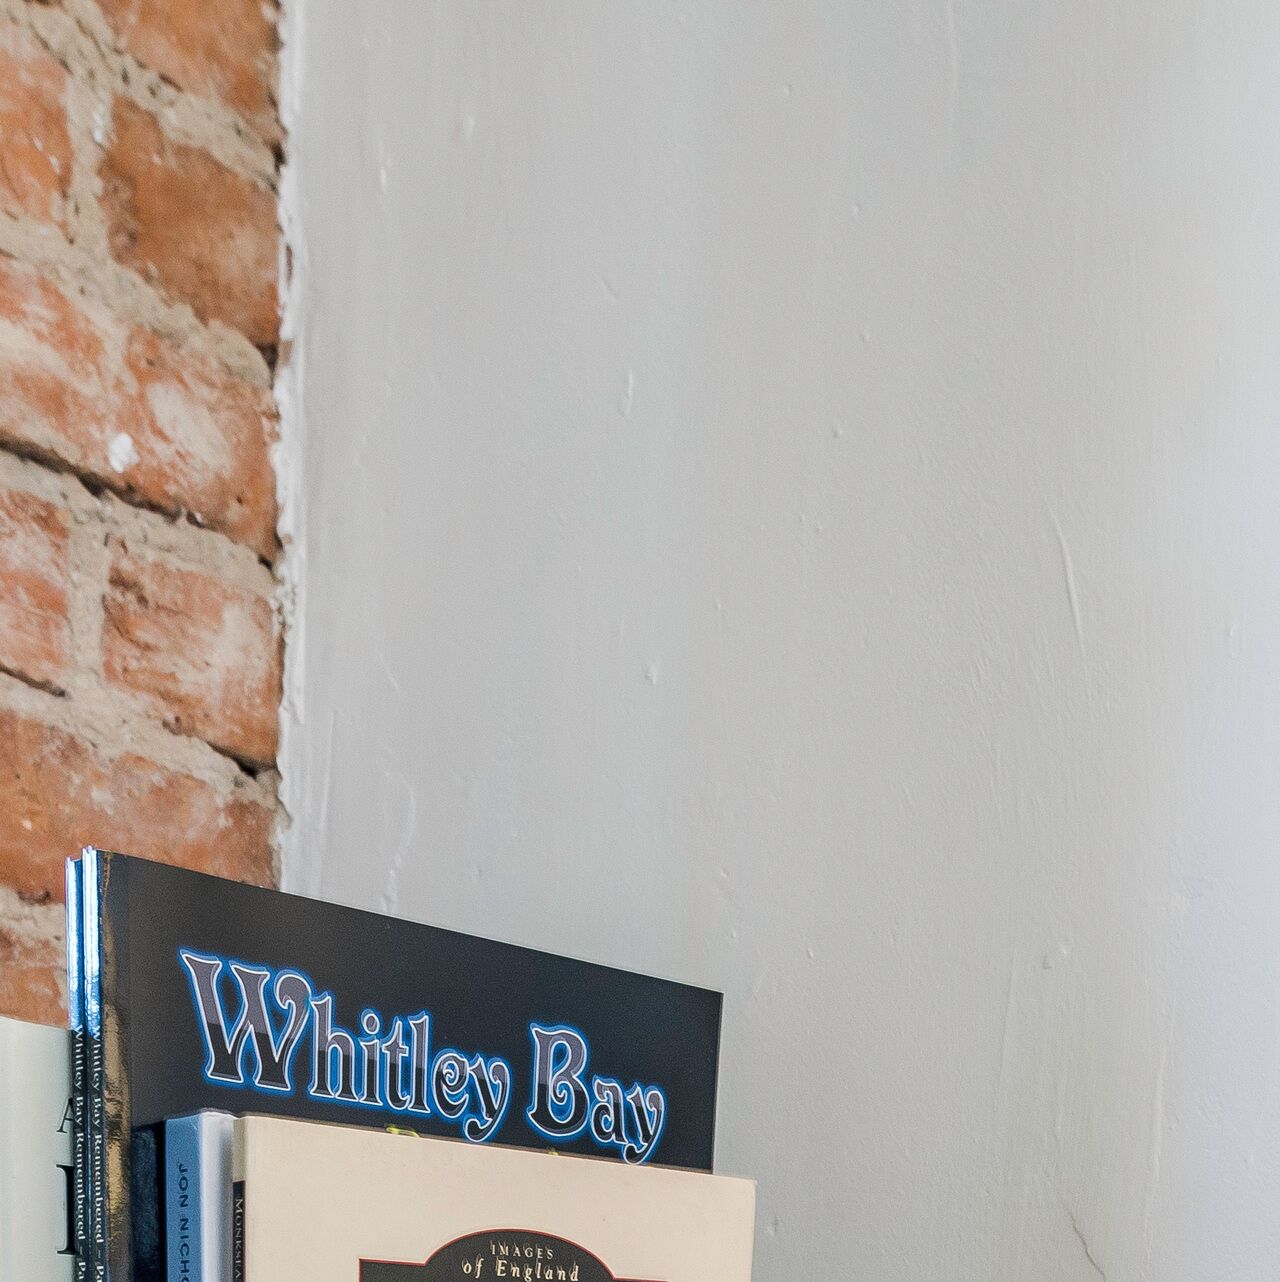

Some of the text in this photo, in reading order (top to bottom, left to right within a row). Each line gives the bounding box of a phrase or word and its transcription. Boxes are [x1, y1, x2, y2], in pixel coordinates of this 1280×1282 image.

[72, 1025, 84, 1091] Whitley
[91, 1025, 102, 1091] Whitley
[180, 949, 666, 1165] Whitley Bay
[75, 1096, 84, 1126] Bay
[93, 1097, 103, 1128] Bay
[76, 1132, 86, 1240] Remembered
[94, 1133, 104, 1243] Remembered
[178, 1163, 188, 1209] JON
[462, 1256, 580, 1282] of England
[489, 1242, 554, 1260] IMAGES
